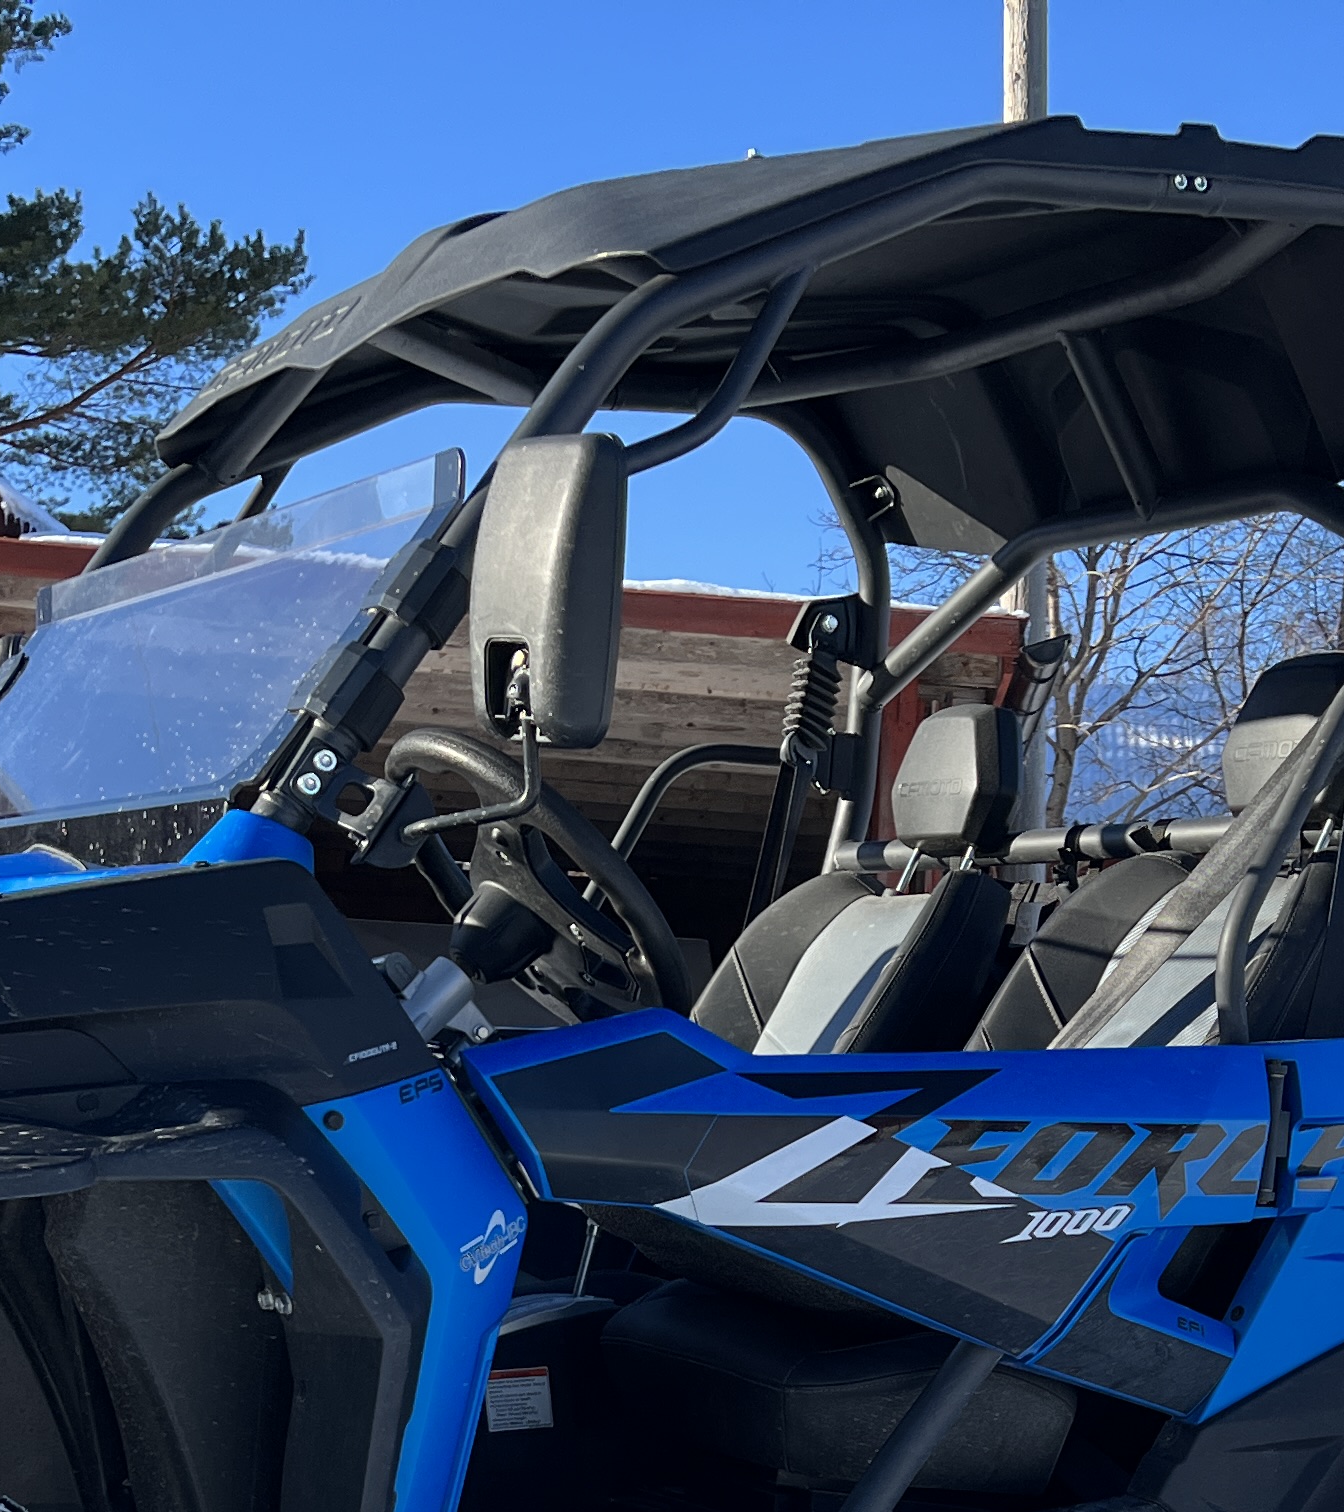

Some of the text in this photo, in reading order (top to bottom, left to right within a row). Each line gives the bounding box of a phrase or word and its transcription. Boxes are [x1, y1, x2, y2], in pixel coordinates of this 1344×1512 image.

[399, 1073, 444, 1105] EPS
[1001, 1203, 1135, 1243] 1000
[1177, 1316, 1205, 1338] EFI
